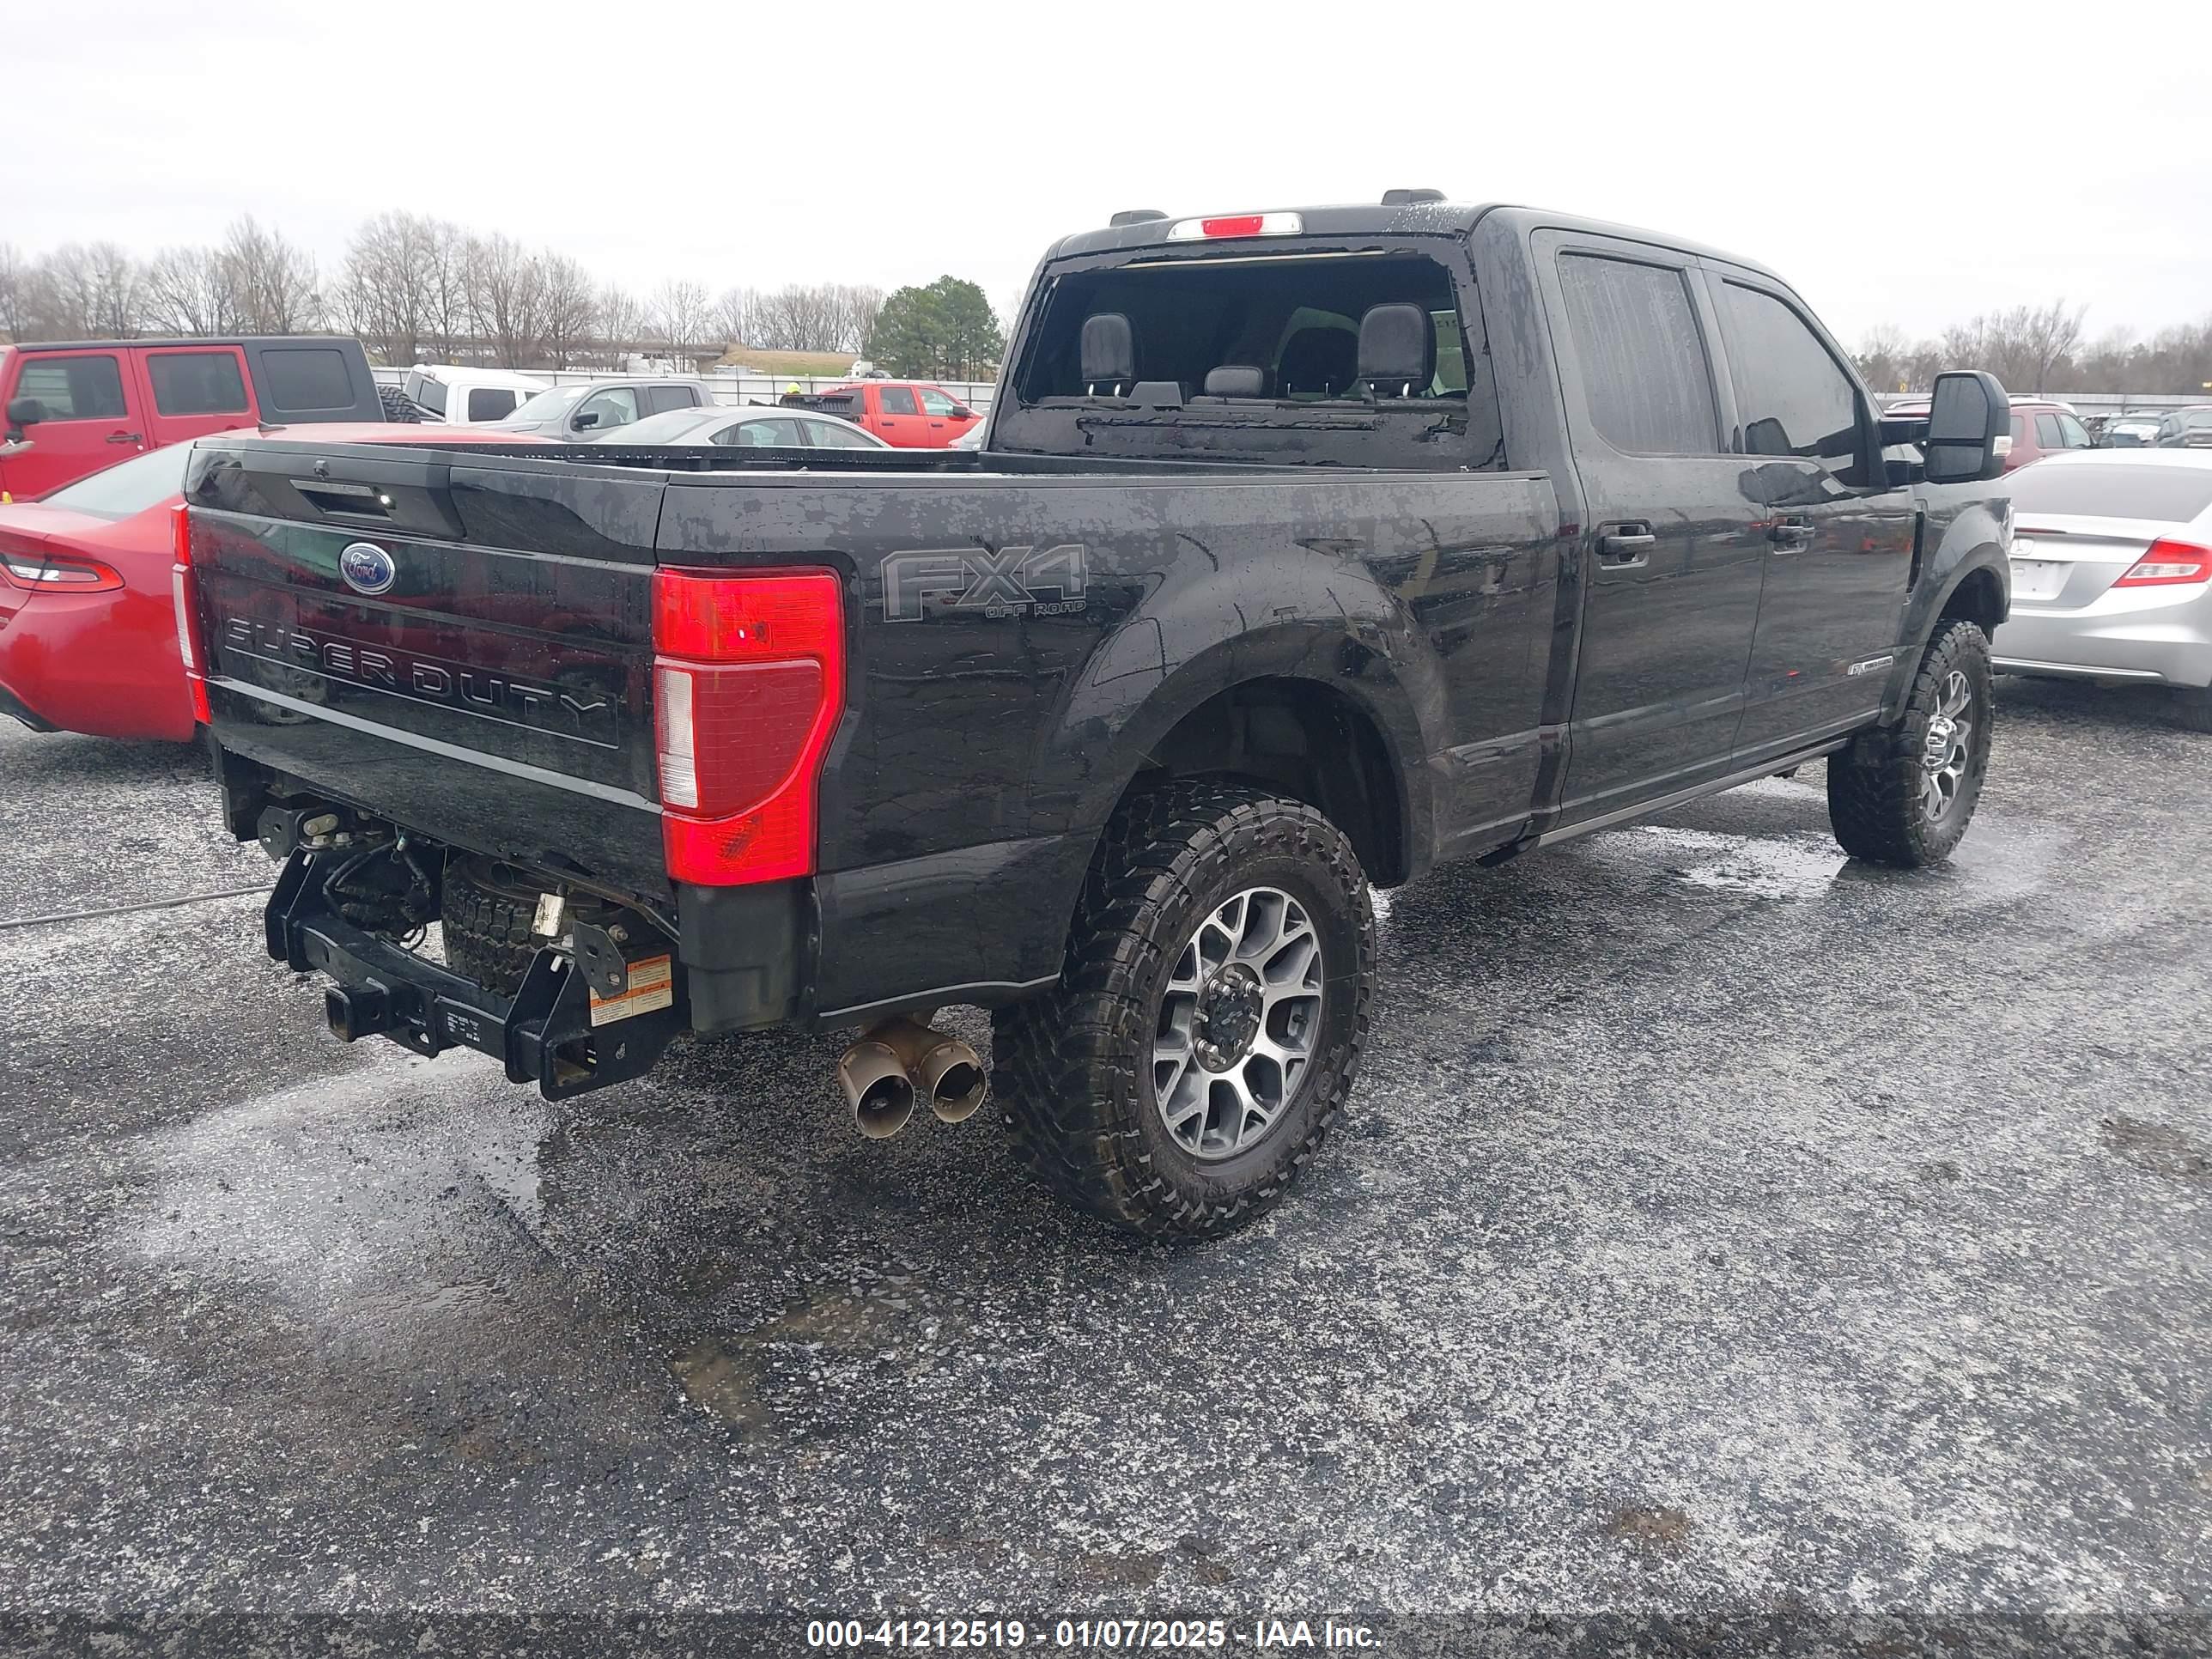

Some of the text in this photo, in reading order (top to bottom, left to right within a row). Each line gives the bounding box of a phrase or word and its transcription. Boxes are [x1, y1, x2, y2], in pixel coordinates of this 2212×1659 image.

[348, 551, 378, 580] Ford
[880, 544, 1089, 623] FX4
[985, 600, 1087, 619] OFF ROAD
[227, 617, 608, 730] SUPER DUTY
